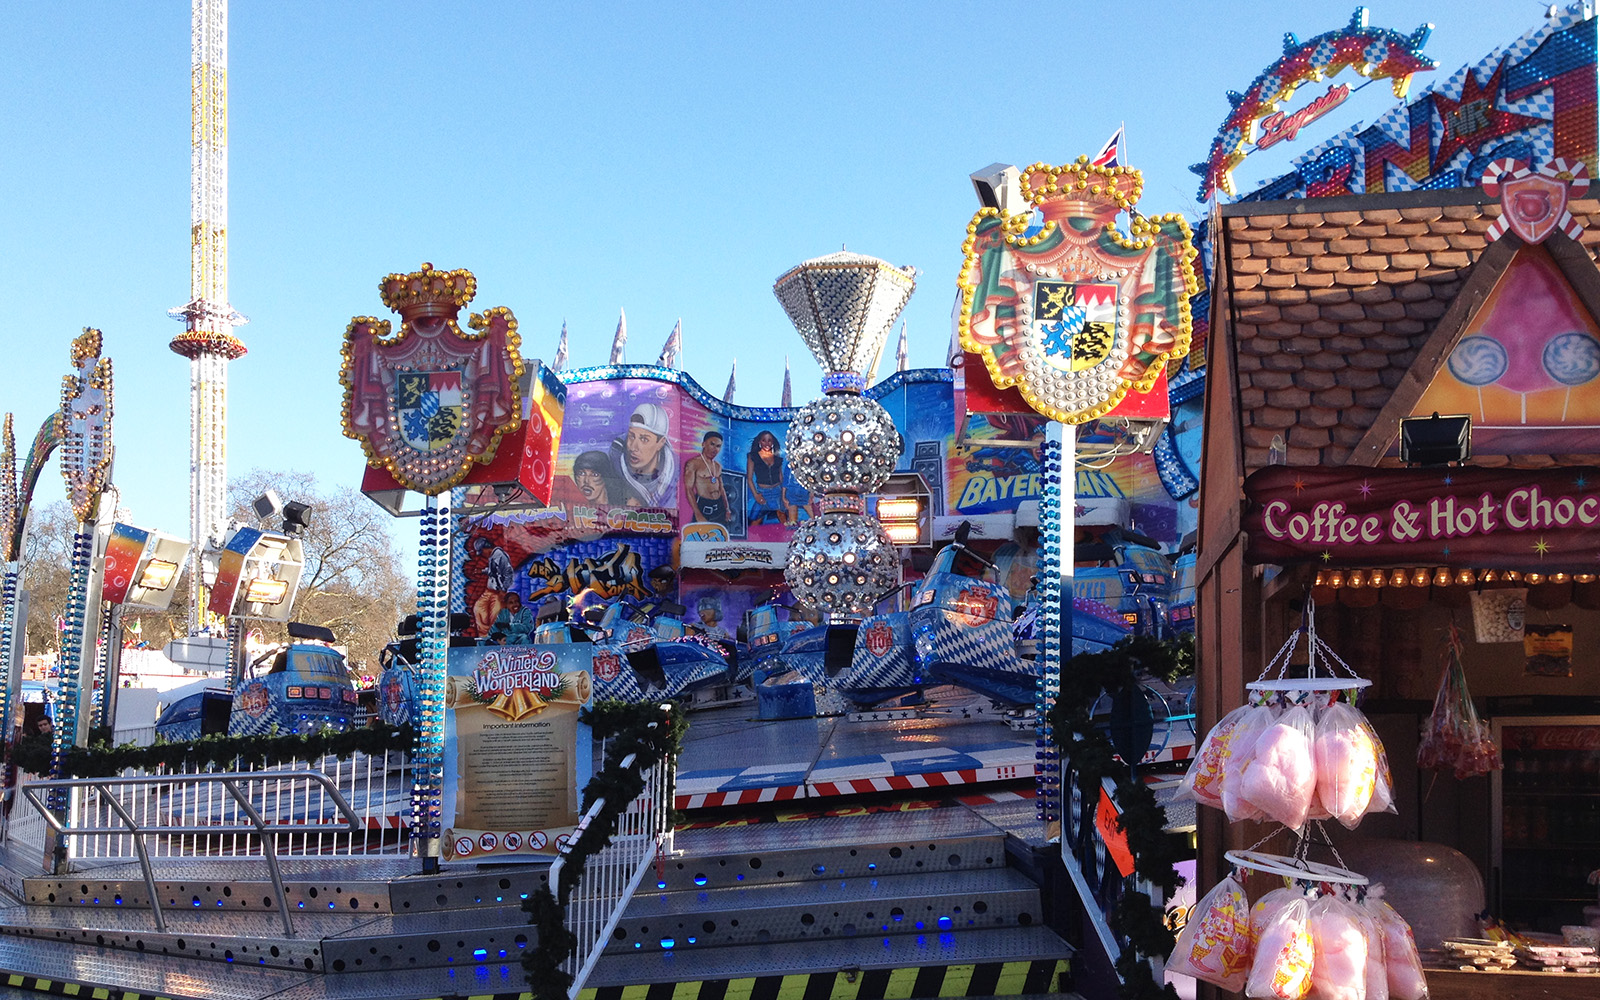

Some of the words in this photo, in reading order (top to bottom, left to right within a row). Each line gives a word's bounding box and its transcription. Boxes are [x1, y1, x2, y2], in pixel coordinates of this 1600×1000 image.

[1447, 98, 1491, 141] NR
[1264, 501, 1381, 543] Coffee
[1391, 502, 1421, 540] &
[1430, 494, 1495, 537] Hot
[1507, 487, 1599, 529] Choc
